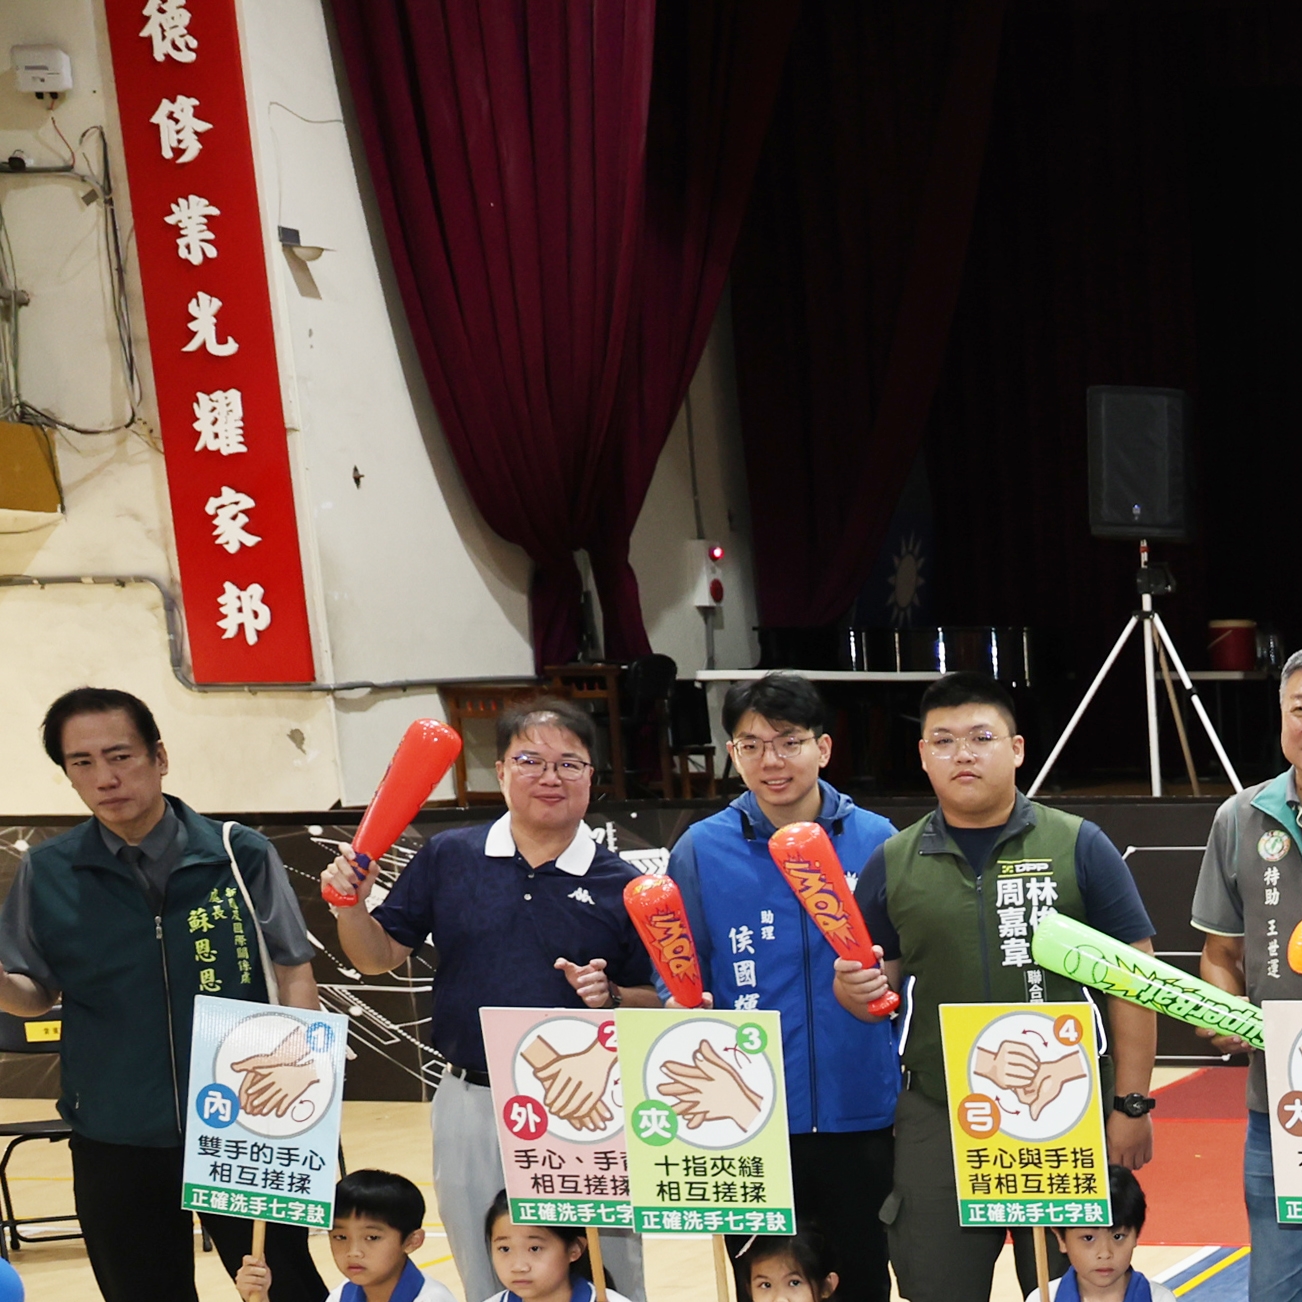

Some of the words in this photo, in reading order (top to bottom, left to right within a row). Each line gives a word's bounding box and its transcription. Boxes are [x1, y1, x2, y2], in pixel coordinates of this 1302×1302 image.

[1263, 866, 1281, 906] 特助
[760, 910, 776, 940] 助理
[742, 1027, 762, 1050] 3
[1058, 1019, 1079, 1042] 4
[509, 1103, 541, 1133] 外
[638, 1106, 672, 1139] 夾
[964, 1101, 994, 1132] 弓
[197, 1135, 326, 1171] 雙手的手心
[966, 1147, 1095, 1170] 手心與手指
[208, 1161, 312, 1195] 相互搓揉
[655, 1155, 765, 1178] 十指夾縫
[656, 1181, 767, 1204] 相互搓揉
[968, 1173, 1098, 1195] 背相互搓揉
[190, 1188, 326, 1225] 正確洗手七字訣
[967, 1202, 1104, 1223] 正確洗手七字訣
[641, 1210, 787, 1232] 正確洗手七字訣
